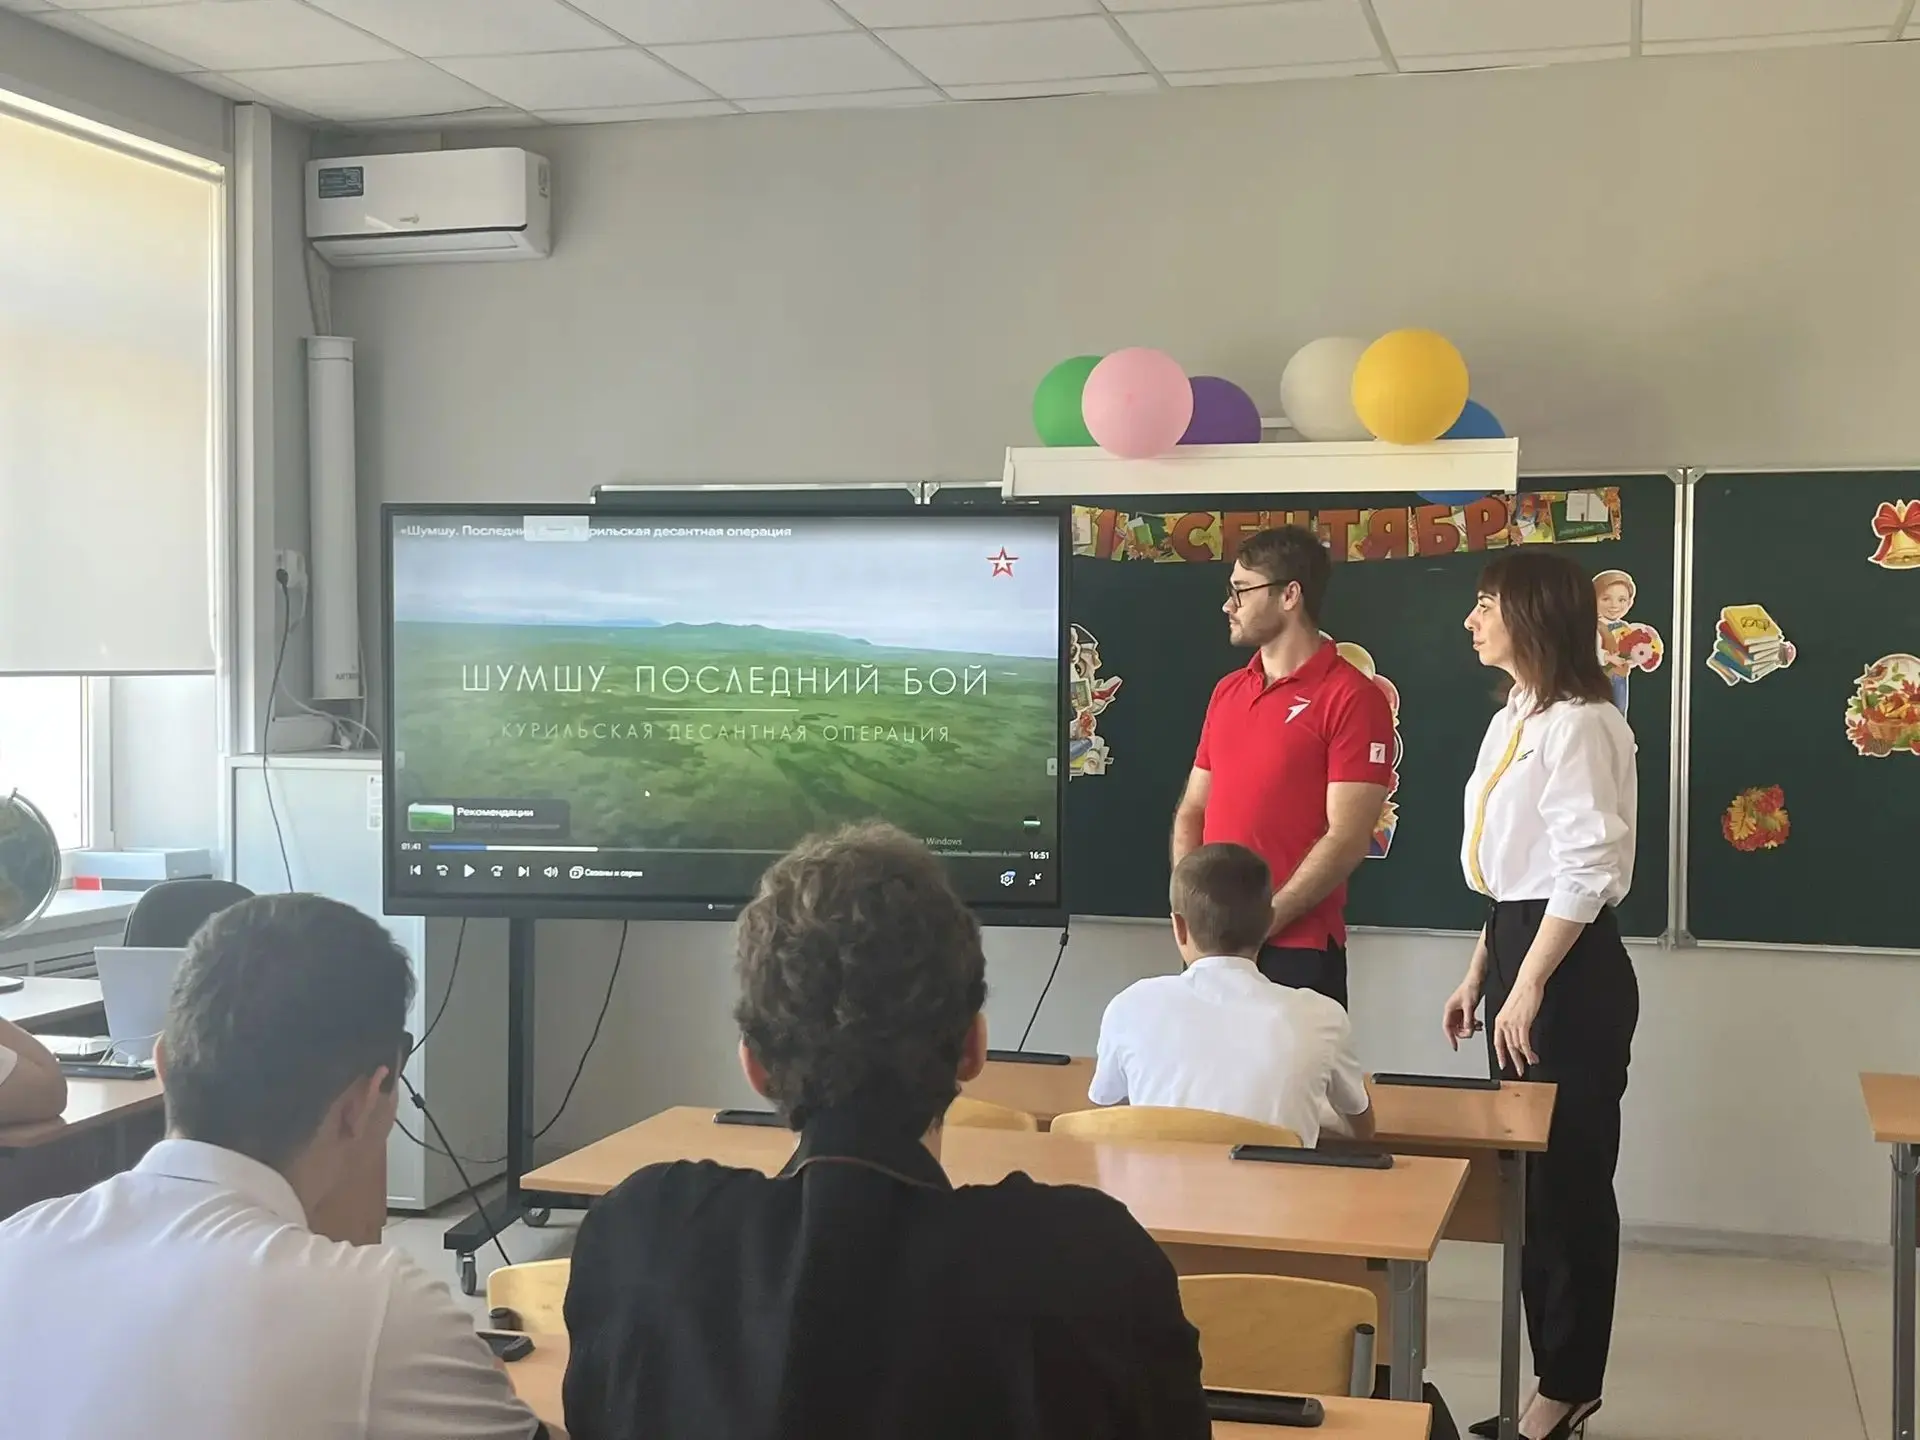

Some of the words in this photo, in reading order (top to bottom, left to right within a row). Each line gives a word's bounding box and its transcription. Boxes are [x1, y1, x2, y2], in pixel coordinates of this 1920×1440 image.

[462, 525, 527, 538] Последни
[653, 527, 724, 538] десантная
[726, 527, 792, 539] операция
[462, 664, 613, 693] ШУМШУ.
[636, 663, 880, 697] ПОСЛЕДНИЙ
[904, 664, 988, 696] БОЙ
[502, 722, 654, 740] КУРИЛЬСКАЯ
[668, 723, 807, 741] ДЕСАНТНАЯ
[823, 724, 949, 744] ОПЕРАЦИЯ
[456, 807, 534, 818] Рекомендации
[1029, 851, 1050, 860] 16:51
